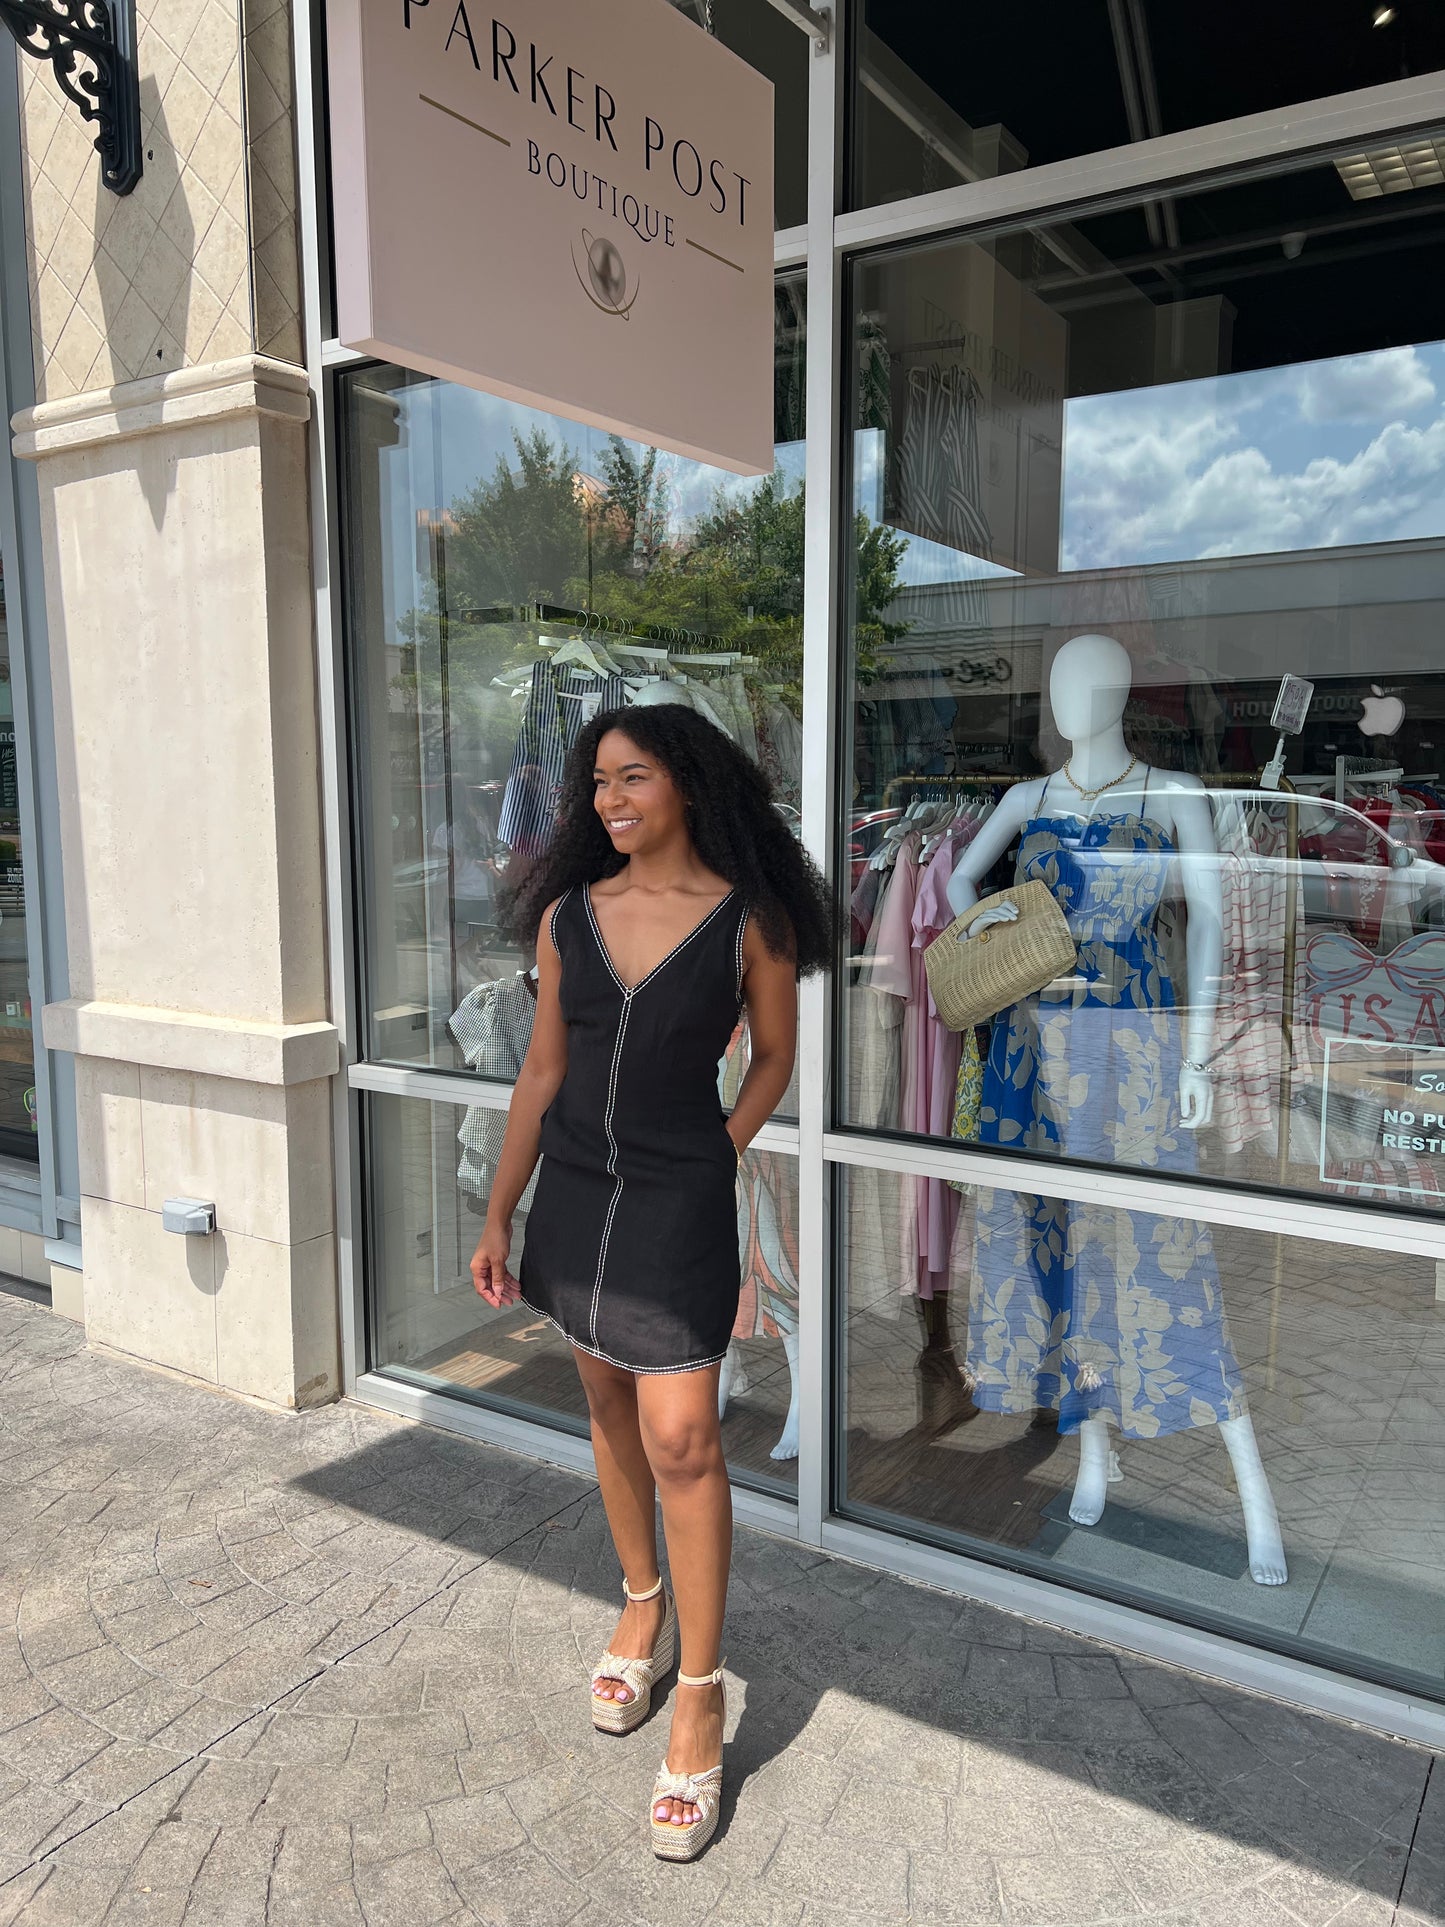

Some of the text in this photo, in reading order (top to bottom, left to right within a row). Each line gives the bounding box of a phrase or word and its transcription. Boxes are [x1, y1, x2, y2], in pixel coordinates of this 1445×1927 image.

[526, 138, 675, 247] BOUTIQUE
[645, 116, 751, 226] POST
[1309, 993, 1445, 1051] USA
[1383, 1109, 1415, 1126] NO
